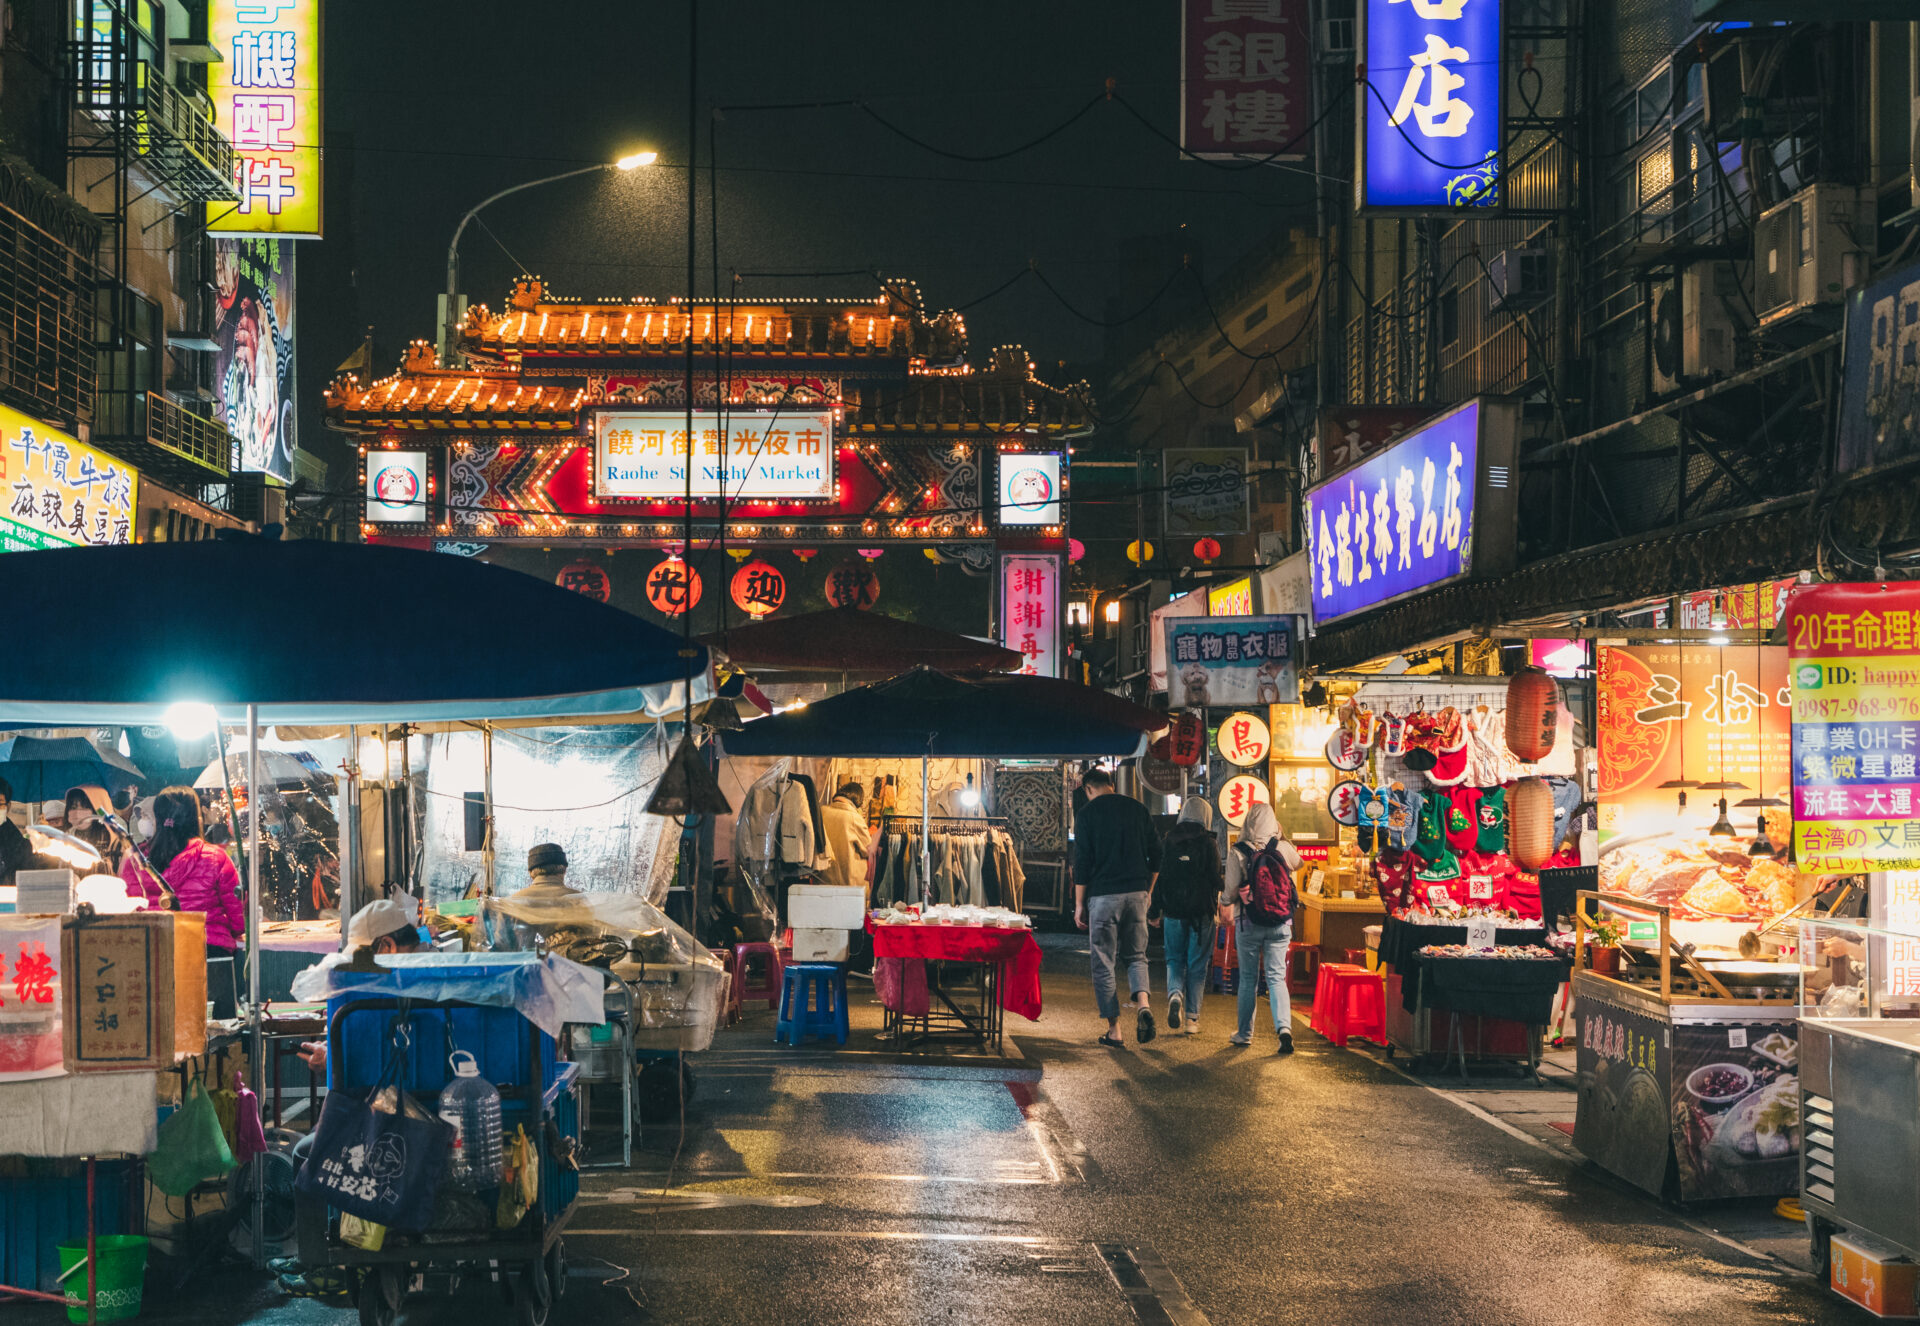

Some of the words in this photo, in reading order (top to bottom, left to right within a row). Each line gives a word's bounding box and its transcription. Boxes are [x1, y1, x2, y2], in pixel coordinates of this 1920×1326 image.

[608, 429, 823, 456] 饒河街觀光夜市
[11, 430, 131, 509] 平價牛排
[607, 466, 659, 480] Raohe
[702, 466, 746, 483] Night
[759, 466, 820, 480] Market
[11, 477, 130, 545] 麻辣臭豆腐
[650, 568, 687, 605] 光
[743, 570, 780, 608] 迎
[1827, 667, 1857, 685] ID:
[1798, 696, 1919, 718] 0987-968-976
[1473, 929, 1487, 939] 20
